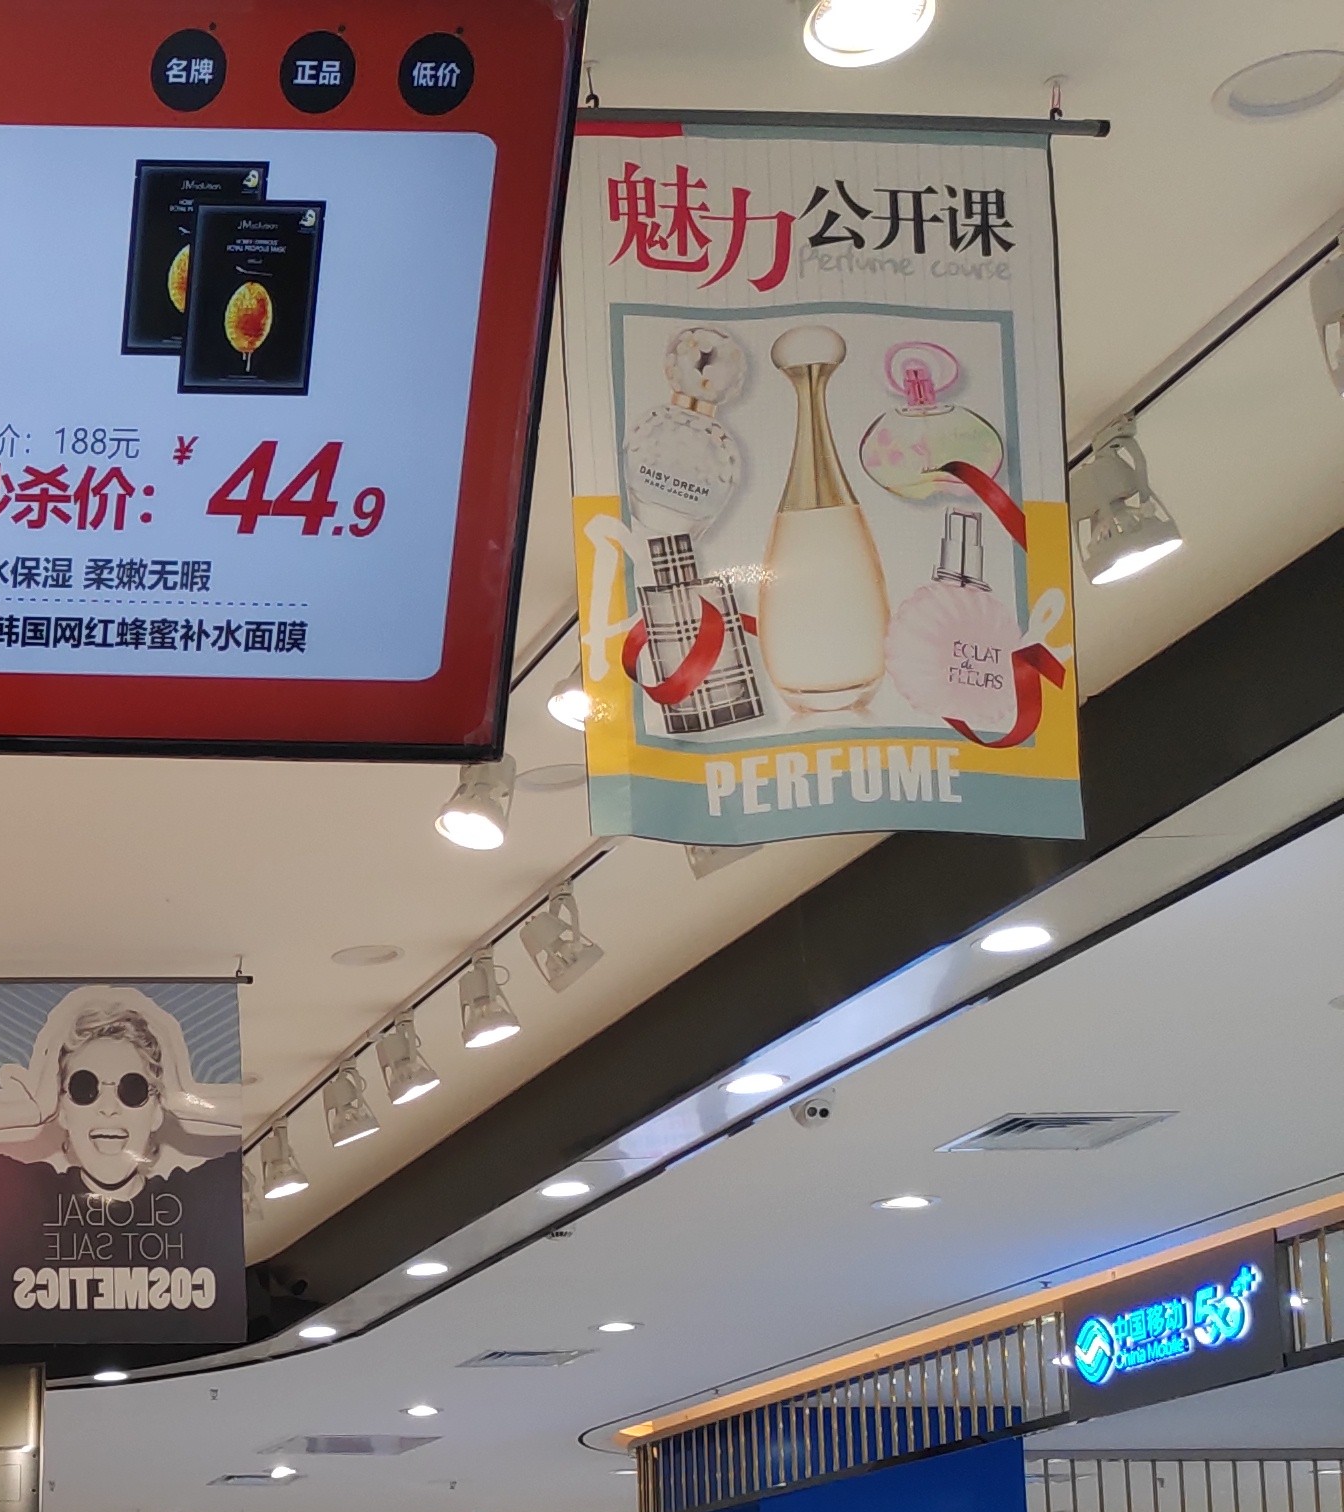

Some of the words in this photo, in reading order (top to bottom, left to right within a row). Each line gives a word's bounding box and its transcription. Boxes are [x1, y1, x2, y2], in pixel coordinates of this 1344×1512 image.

[166, 58, 213, 84] 名牌
[293, 60, 341, 85] 正品
[412, 62, 460, 89] 低价
[640, 466, 670, 481] DAISY
[673, 478, 709, 496] DREAM
[83, 558, 212, 593] 柔嫩无暇
[705, 746, 962, 816] PERFUME
[1113, 1297, 1187, 1346] 中国移动
